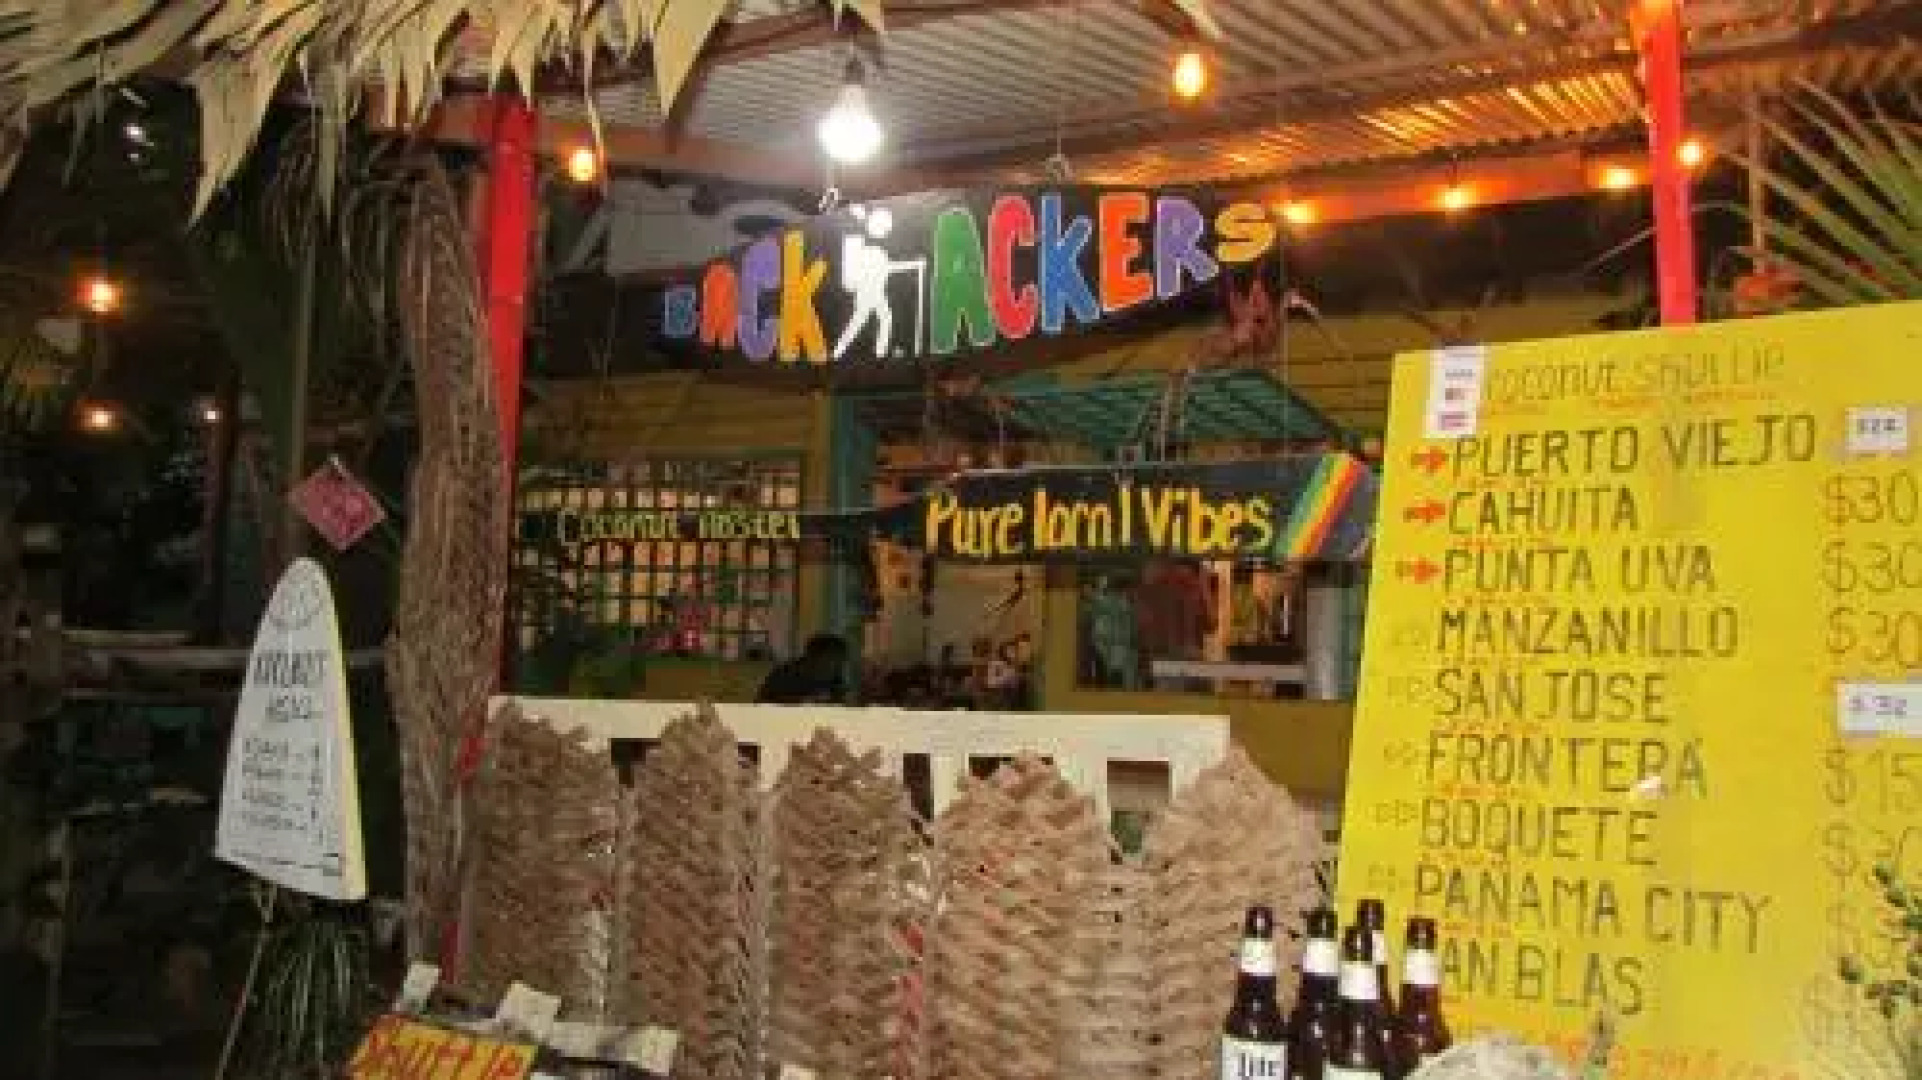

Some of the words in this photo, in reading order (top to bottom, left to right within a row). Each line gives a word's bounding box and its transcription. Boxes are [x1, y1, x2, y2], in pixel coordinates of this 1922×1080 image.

[1450, 426, 1640, 478] PUERTO
[1660, 414, 1816, 468] VIEJO
[924, 490, 1026, 559] Pure
[1140, 488, 1277, 553] Vibes
[1447, 487, 1640, 535] CAHUITA
[1822, 470, 1921, 526] $30
[1443, 547, 1598, 593] PUNTA
[1620, 544, 1718, 593] UVA
[1435, 607, 1739, 656] MANZANILLO
[1434, 668, 1524, 720] SAN
[1540, 671, 1669, 724] JOSE
[1420, 798, 1659, 866] BOQUETE
[1414, 863, 1620, 939] PANAMA
[1644, 886, 1773, 954] CITY
[1443, 936, 1500, 998] AN
[1514, 944, 1643, 1016] BLAS
